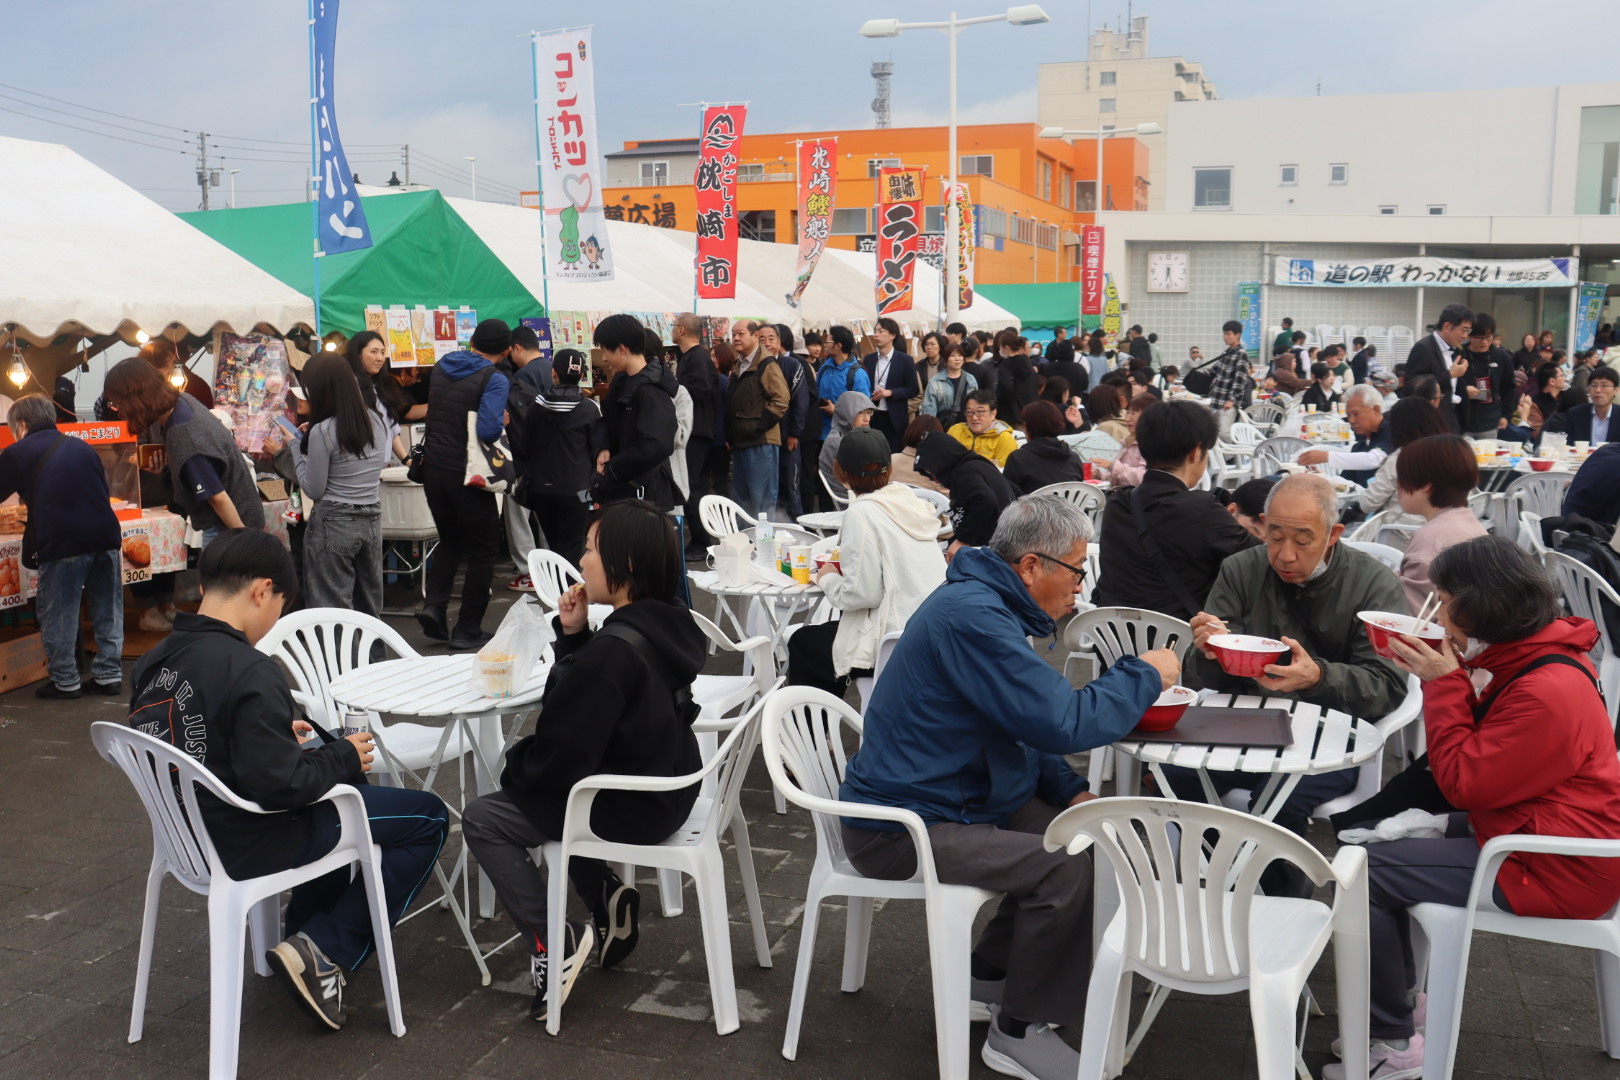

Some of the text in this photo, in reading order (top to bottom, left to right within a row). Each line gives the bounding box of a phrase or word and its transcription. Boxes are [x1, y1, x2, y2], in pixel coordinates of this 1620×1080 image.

[547, 116, 562, 171] プロジェクト
[722, 152, 736, 218] かごしま
[696, 157, 732, 288] 枕崎市
[878, 204, 919, 312] ラーメン
[1087, 244, 1099, 302] 喫煙エリア
[1323, 264, 1395, 283] 道の駅
[1401, 264, 1501, 283] わっかない
[1587, 300, 1600, 321] 稚内
[90, 426, 120, 440] こまどり
[155, 668, 178, 691] DO
[320, 975, 338, 1000] N
